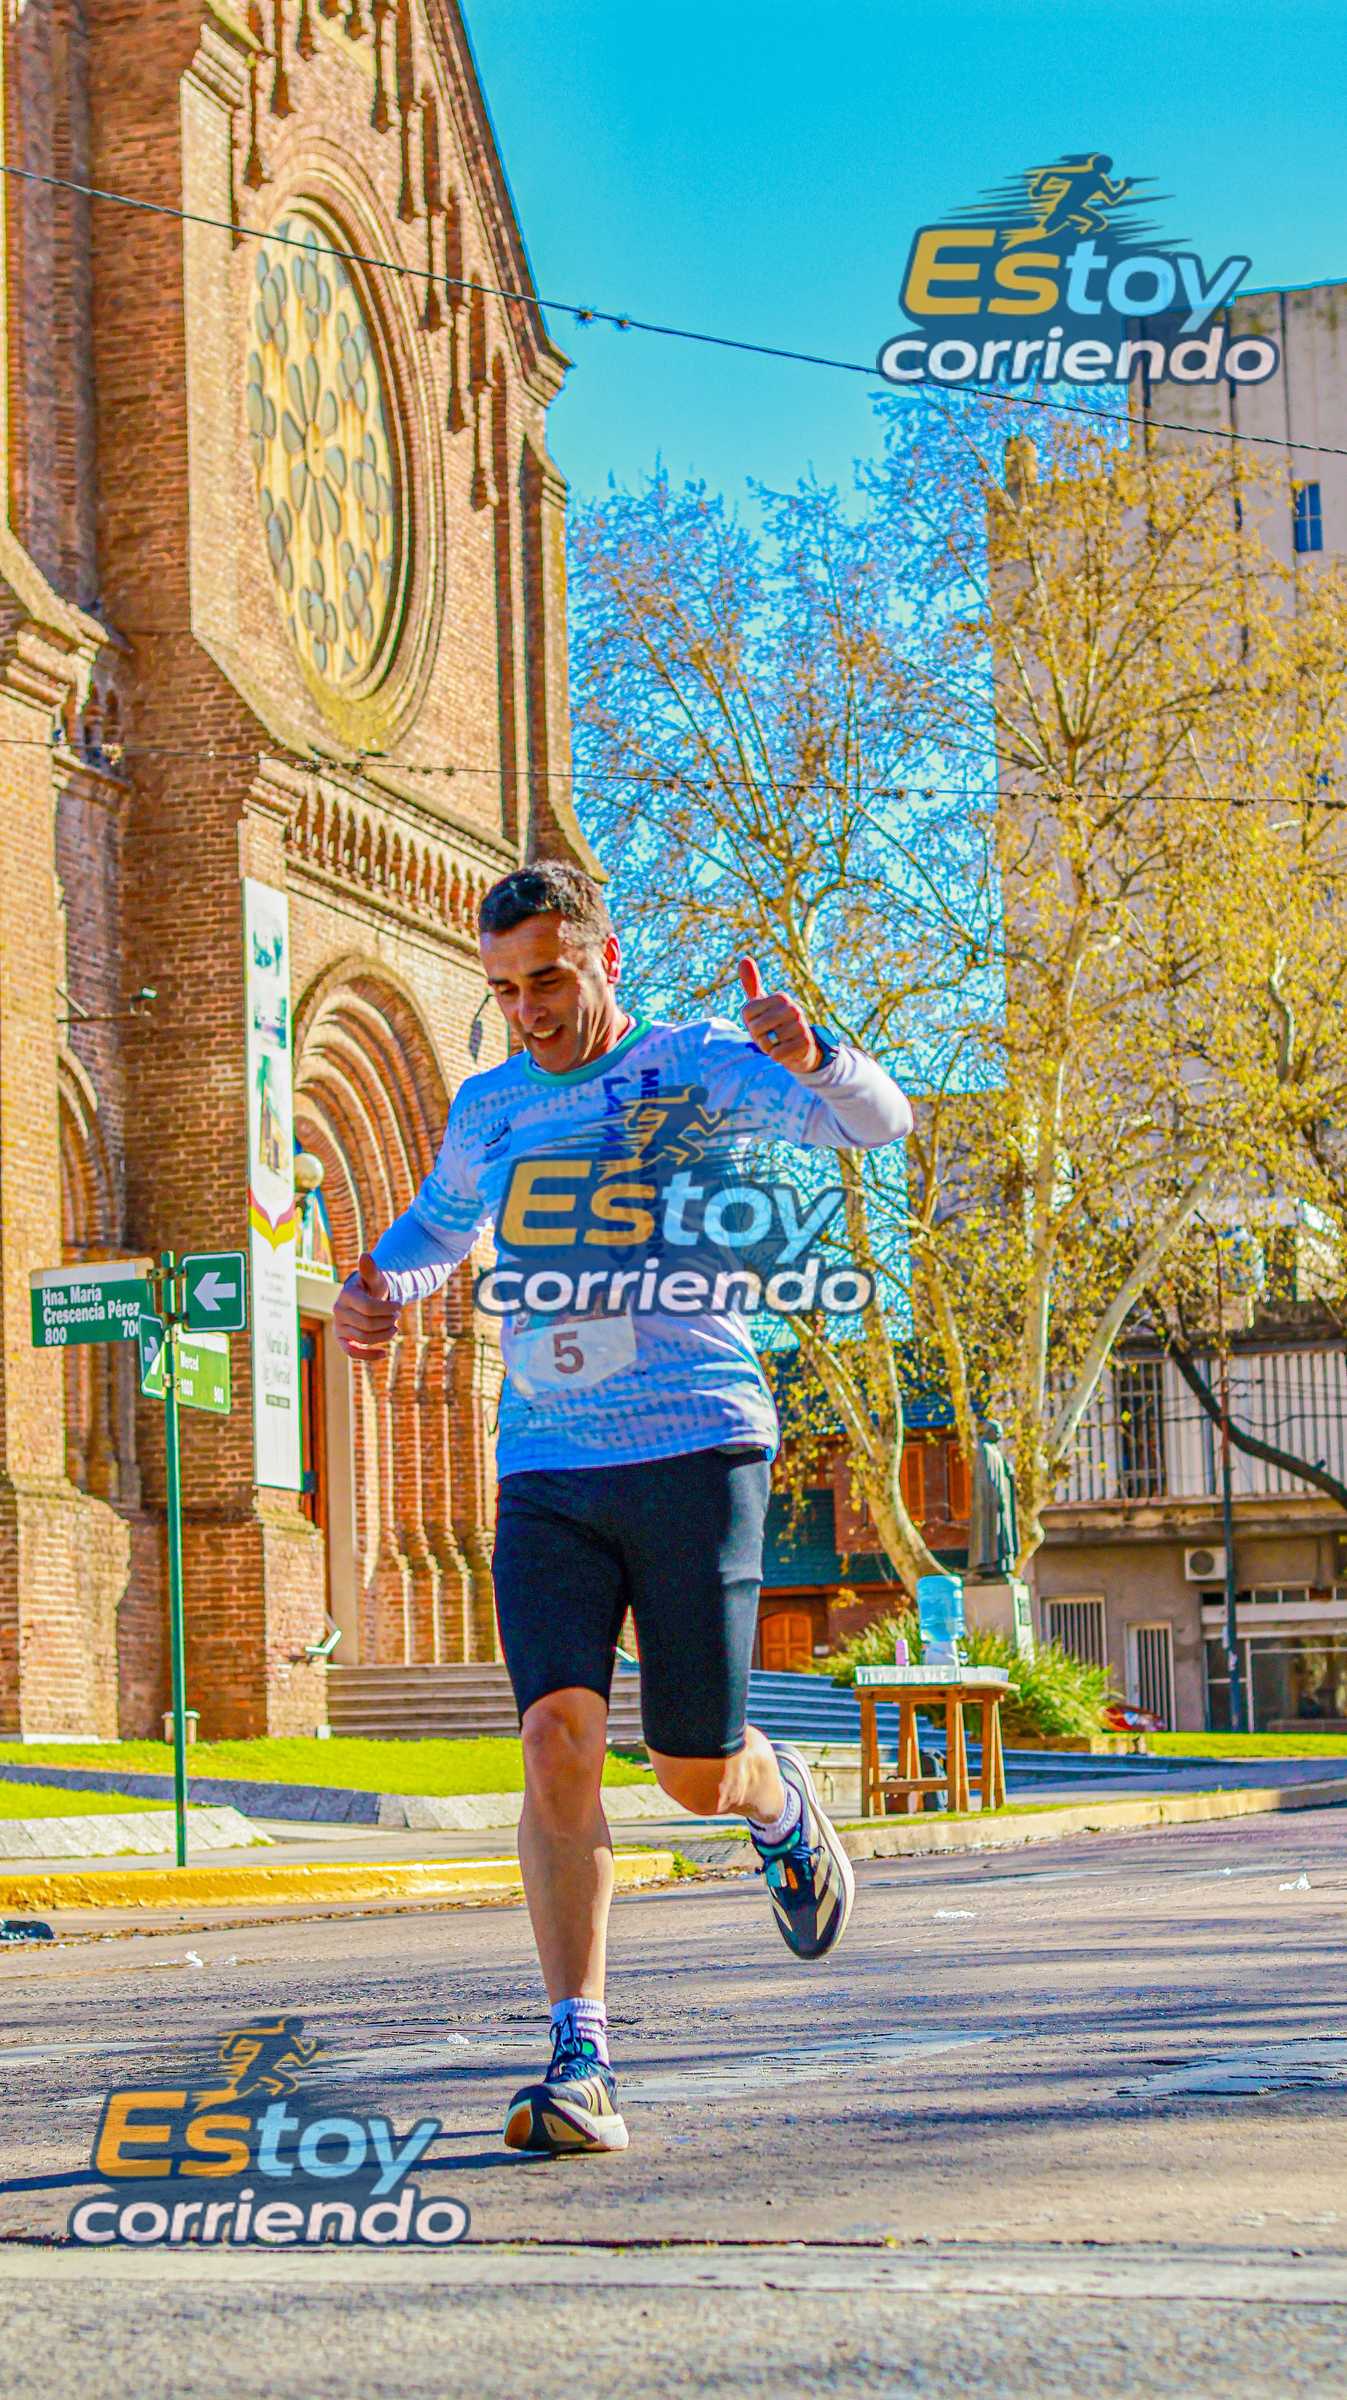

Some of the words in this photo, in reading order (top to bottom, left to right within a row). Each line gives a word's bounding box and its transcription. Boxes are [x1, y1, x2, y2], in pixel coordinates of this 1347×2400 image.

[42, 1289, 68, 1306] Hna.
[43, 1302, 106, 1326] Crescencia
[107, 1299, 140, 1319] Pérez
[45, 1327, 67, 1345] 800
[553, 1331, 584, 1374] 5
